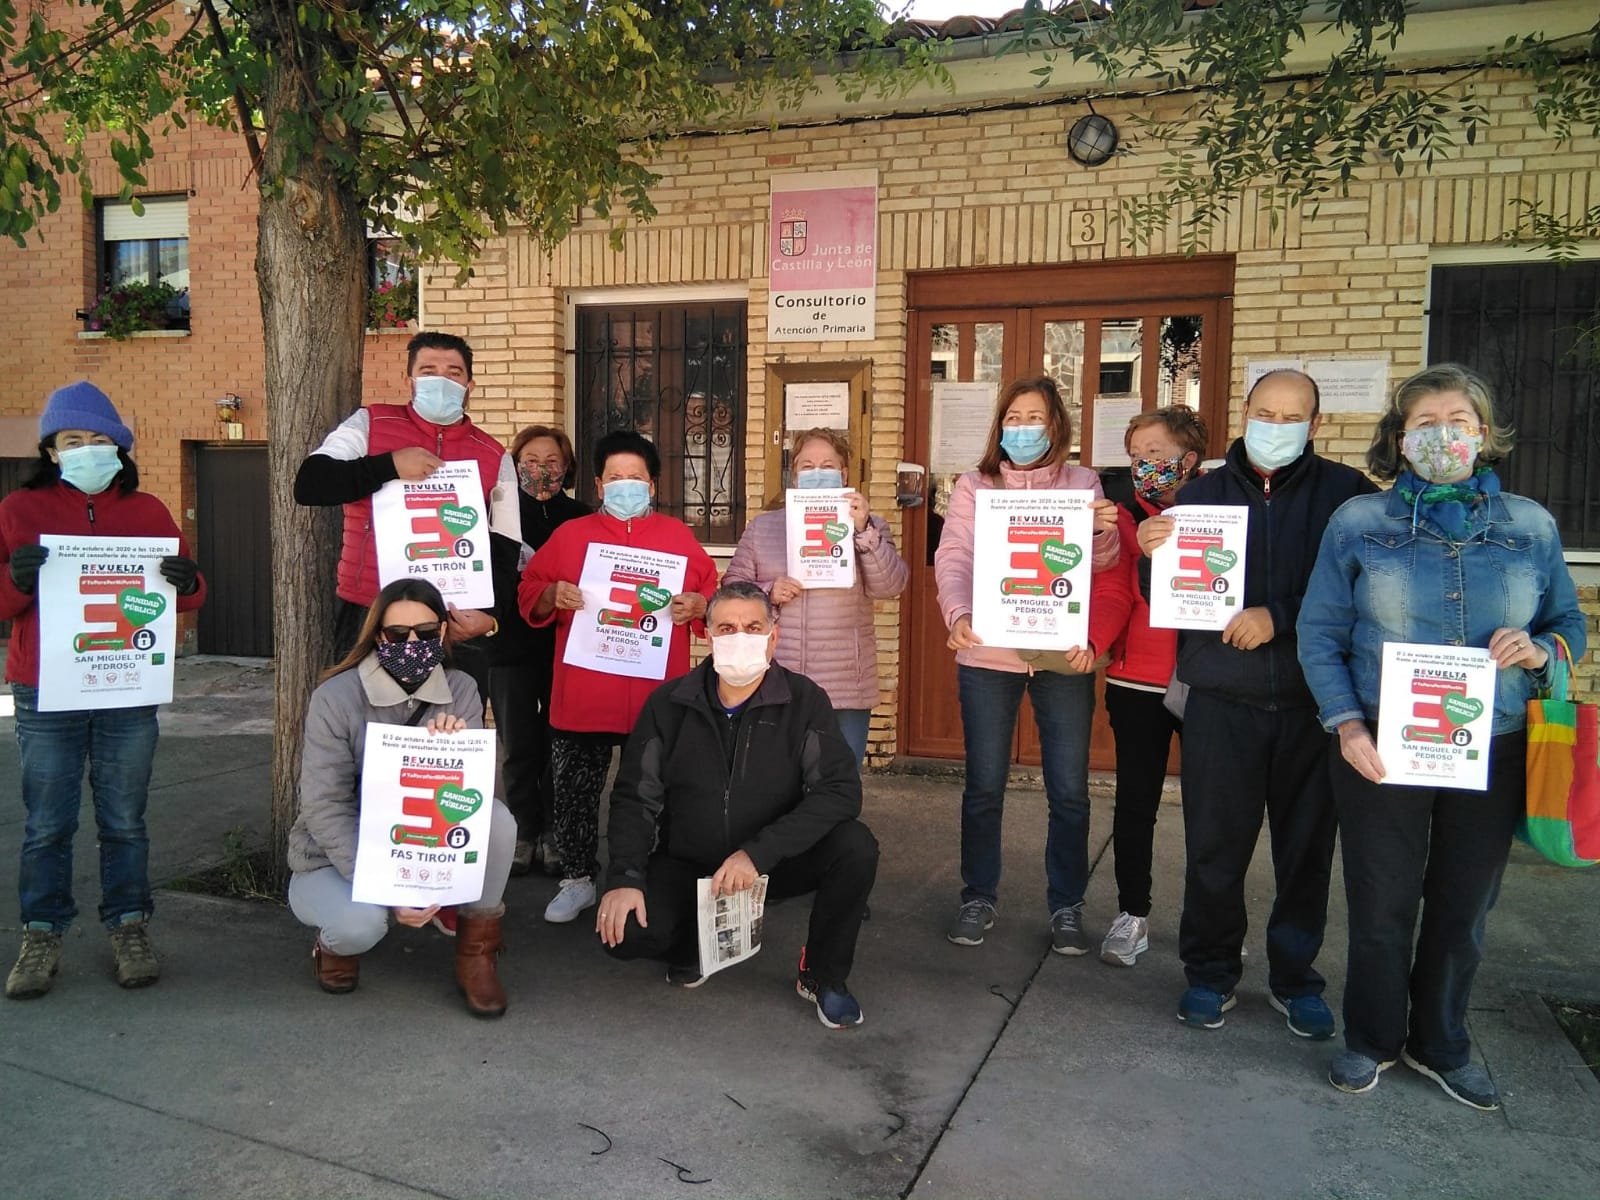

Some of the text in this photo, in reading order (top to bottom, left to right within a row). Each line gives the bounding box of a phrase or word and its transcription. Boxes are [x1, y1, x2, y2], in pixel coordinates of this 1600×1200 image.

[1081, 212, 1095, 242] 3
[812, 243, 873, 257] Junta de
[772, 256, 872, 272] Castilla y León
[775, 294, 867, 308] Consultorio
[812, 311, 827, 320] de
[774, 324, 866, 335] Atención Primaria
[443, 509, 473, 520] SANIDAD
[1046, 545, 1076, 558] SANIDAD
[408, 562, 466, 573] FAS TIRÓN
[614, 564, 660, 576] REVUELTA
[125, 595, 160, 608] SANIDAD
[123, 603, 156, 616] PÚBLICA
[596, 626, 610, 634] SAN
[612, 628, 638, 638] MIGUEL
[606, 636, 640, 646] PEDROSO
[1414, 668, 1467, 678] REVUELTA
[1448, 698, 1478, 711] SANIDAD
[1420, 745, 1449, 754] MIGUEL
[402, 756, 464, 766] REVUELTA
[442, 790, 476, 804] SANIDAD
[440, 799, 472, 812] PÚBLICA
[391, 849, 456, 863] FAS TIRÓN
